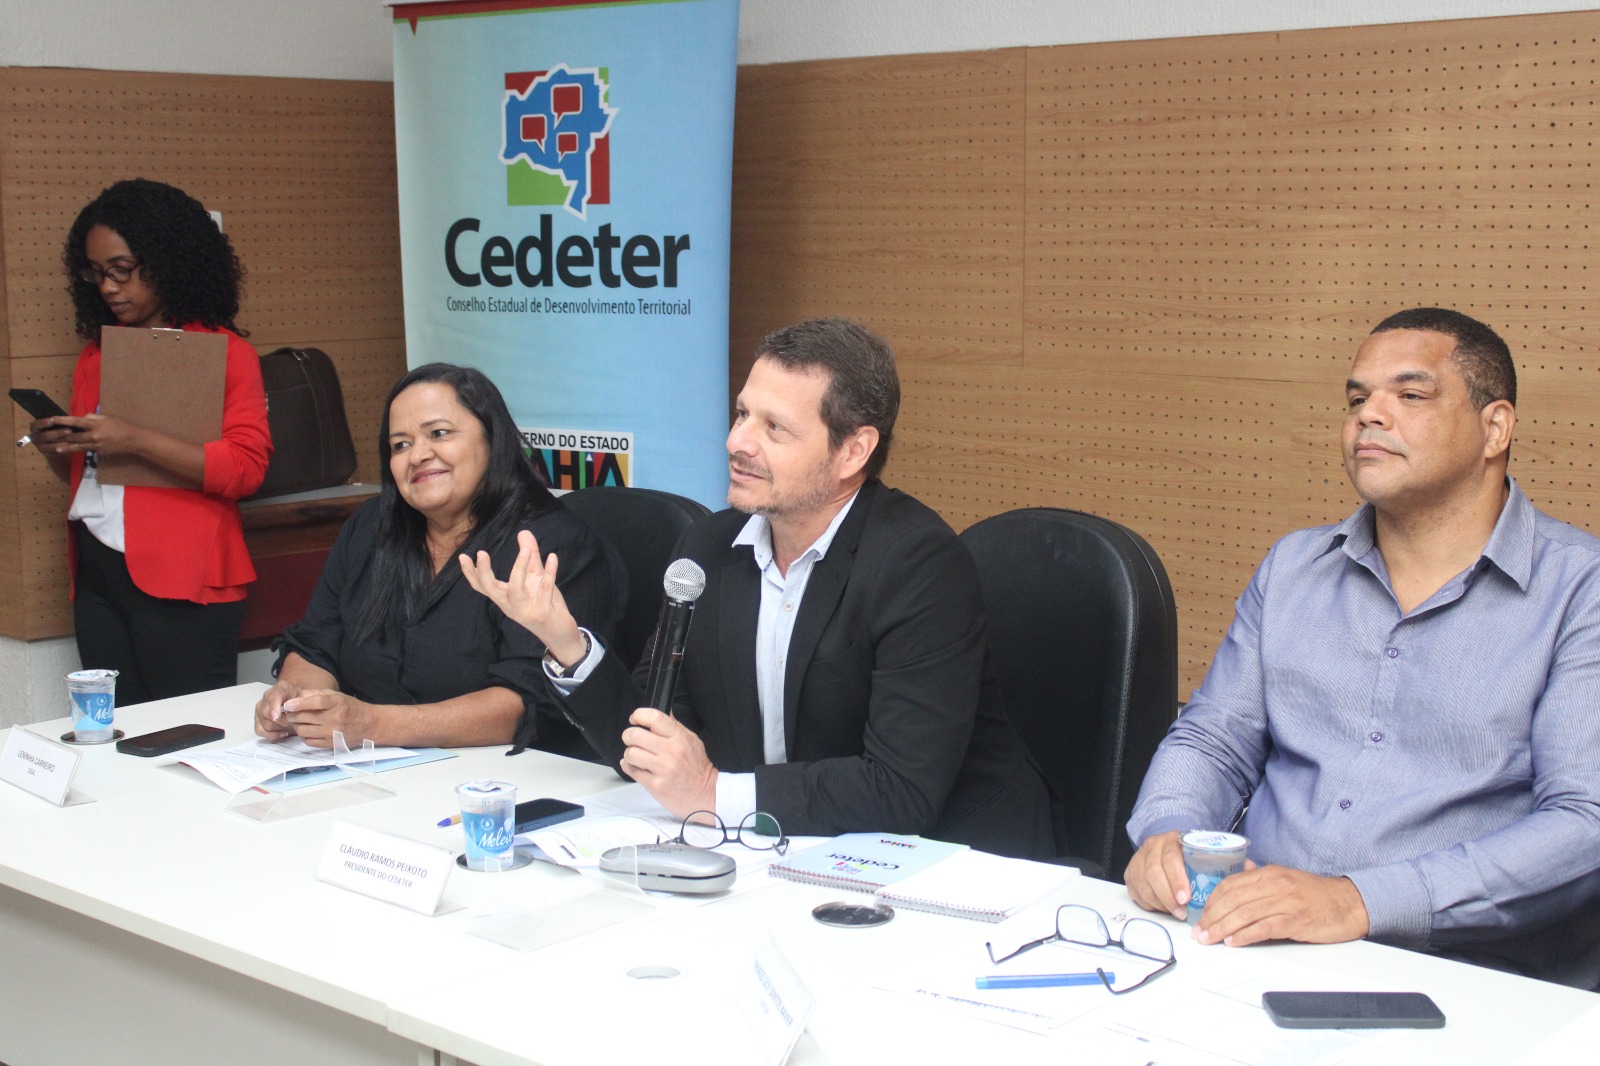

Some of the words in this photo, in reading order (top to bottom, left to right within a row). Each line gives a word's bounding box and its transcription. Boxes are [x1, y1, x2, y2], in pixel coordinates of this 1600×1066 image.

[445, 214, 691, 289] Cedeter
[446, 296, 486, 313] Conselho
[488, 296, 528, 313] Estadual
[530, 297, 542, 313] de
[544, 297, 636, 315] Desenvolvimento
[637, 298, 691, 315] Territorial
[522, 432, 556, 447] ERNO
[558, 434, 577, 448] DO
[580, 435, 630, 451] ESTADO
[34, 757, 56, 773] CARNEIRO
[339, 843, 370, 861] CLÁUDIO
[369, 853, 396, 869] RAMOS
[396, 861, 428, 879] PEIXOTO
[825, 852, 900, 870] Cedeter
[343, 860, 377, 878] PRESIDENTE
[376, 871, 388, 881] DO
[387, 874, 414, 889] CEDETER
